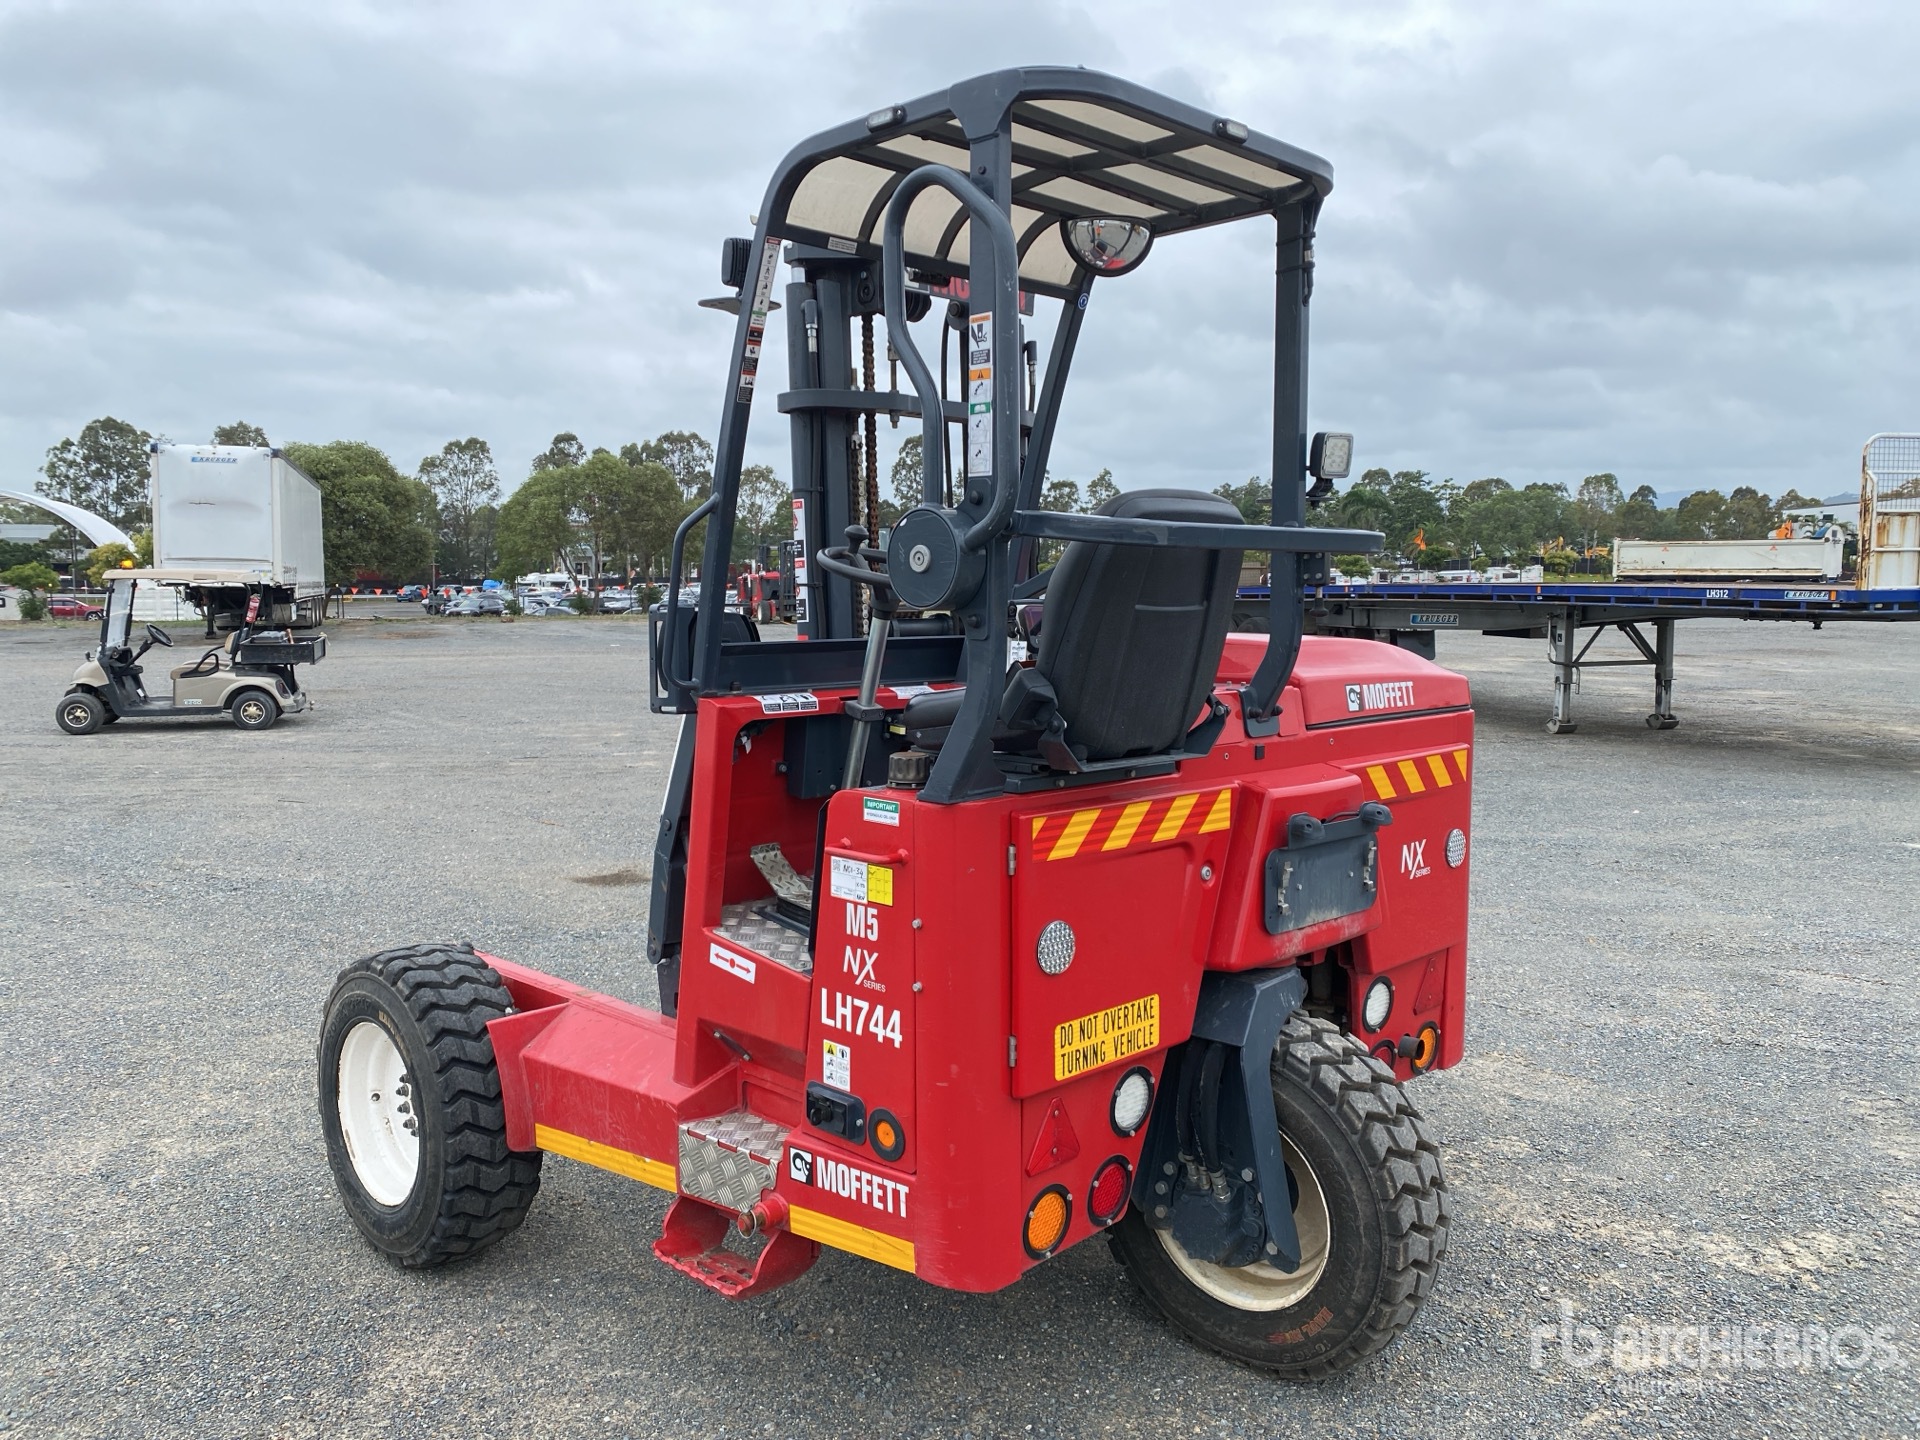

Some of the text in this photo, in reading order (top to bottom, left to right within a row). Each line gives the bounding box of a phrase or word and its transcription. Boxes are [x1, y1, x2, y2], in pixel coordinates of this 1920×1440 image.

[1706, 589, 1729, 598] LH312
[1419, 614, 1458, 623] KRUEGER
[1362, 681, 1415, 710] MOFFETT
[867, 800, 896, 811] IMPORTANT
[1401, 839, 1427, 880] NX
[1415, 866, 1431, 878] SERIES
[846, 902, 879, 942] M5
[843, 945, 879, 985] NX
[863, 979, 886, 993] SERIES
[821, 987, 902, 1049] LH744
[1060, 997, 1155, 1049] DO NOT OVERTAKE
[1061, 1024, 1154, 1077] TURNING VEHICLE
[816, 1156, 909, 1219] MOFFETT
